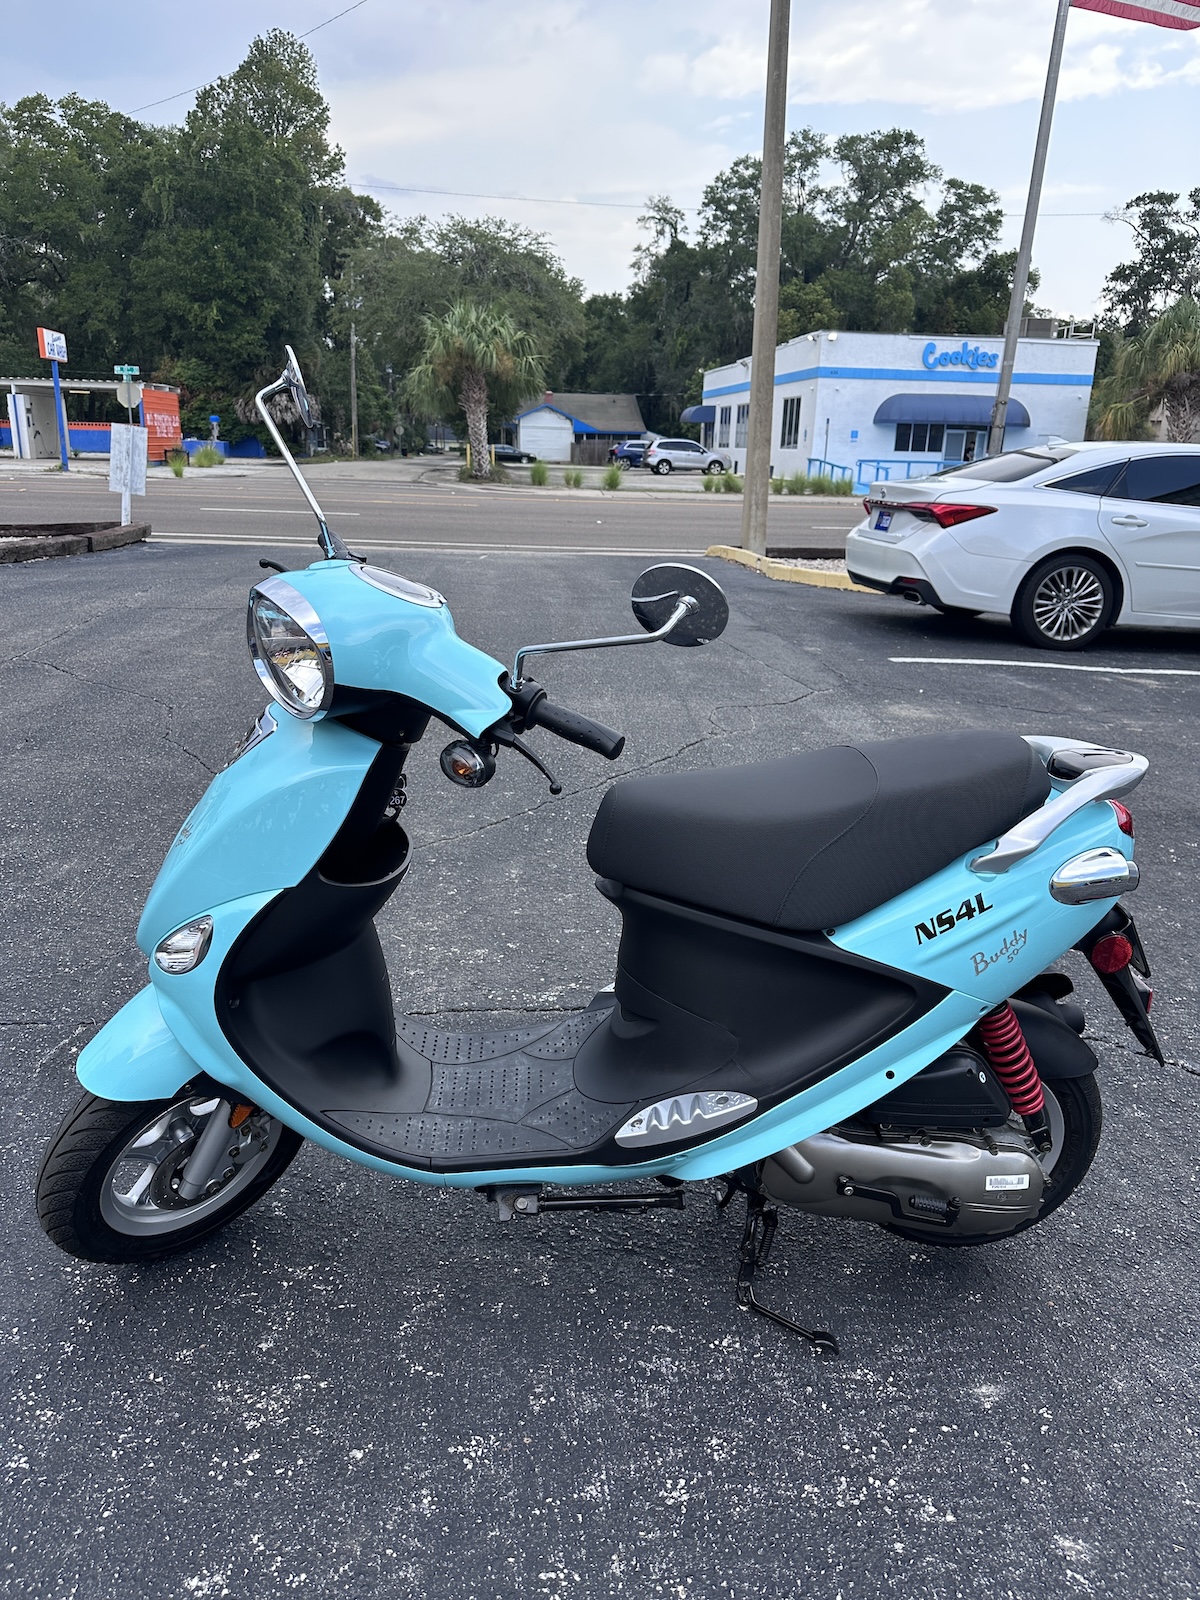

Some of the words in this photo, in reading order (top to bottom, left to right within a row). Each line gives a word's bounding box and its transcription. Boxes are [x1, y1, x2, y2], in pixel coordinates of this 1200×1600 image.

[922, 341, 999, 370] Cookies
[390, 795, 405, 805] 267
[914, 893, 993, 945] NS4L
[970, 928, 1027, 977] Buddy
[1007, 948, 1019, 963] 50
